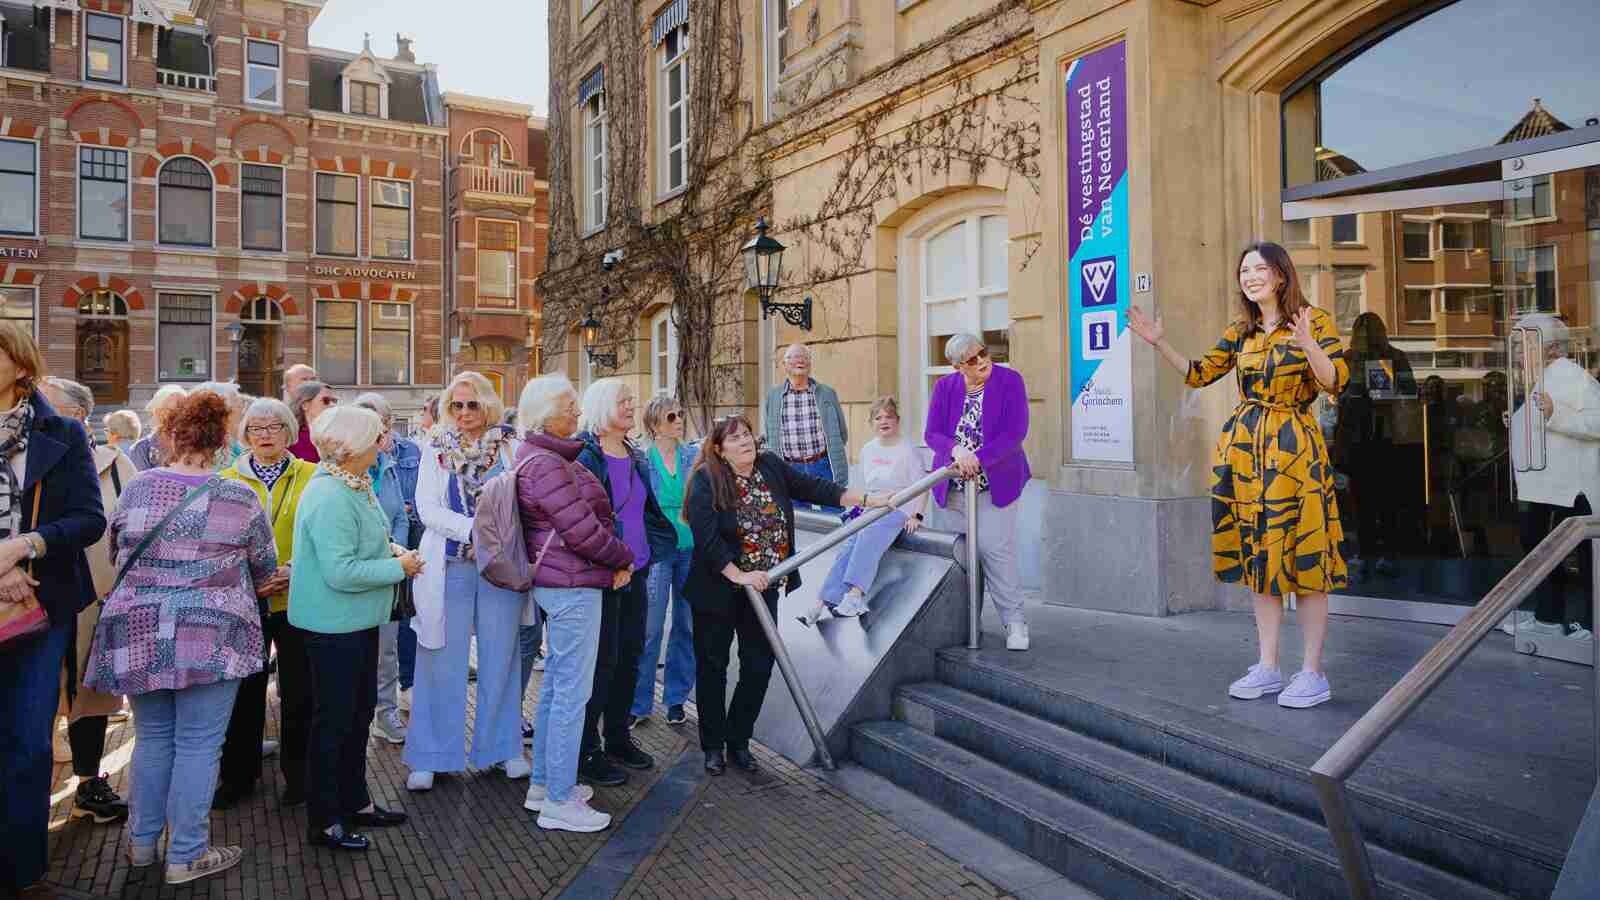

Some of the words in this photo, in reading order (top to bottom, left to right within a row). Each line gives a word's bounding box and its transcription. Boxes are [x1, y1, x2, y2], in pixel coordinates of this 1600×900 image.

[1077, 83, 1095, 209] vestingstad
[1096, 75, 1113, 193] Nederland
[1078, 212, 1094, 242] Dé
[1100, 197, 1113, 239] van
[315, 265, 341, 275] DHC
[344, 267, 416, 280] ADVOCATEN
[1081, 393, 1123, 414] Gorinchem
